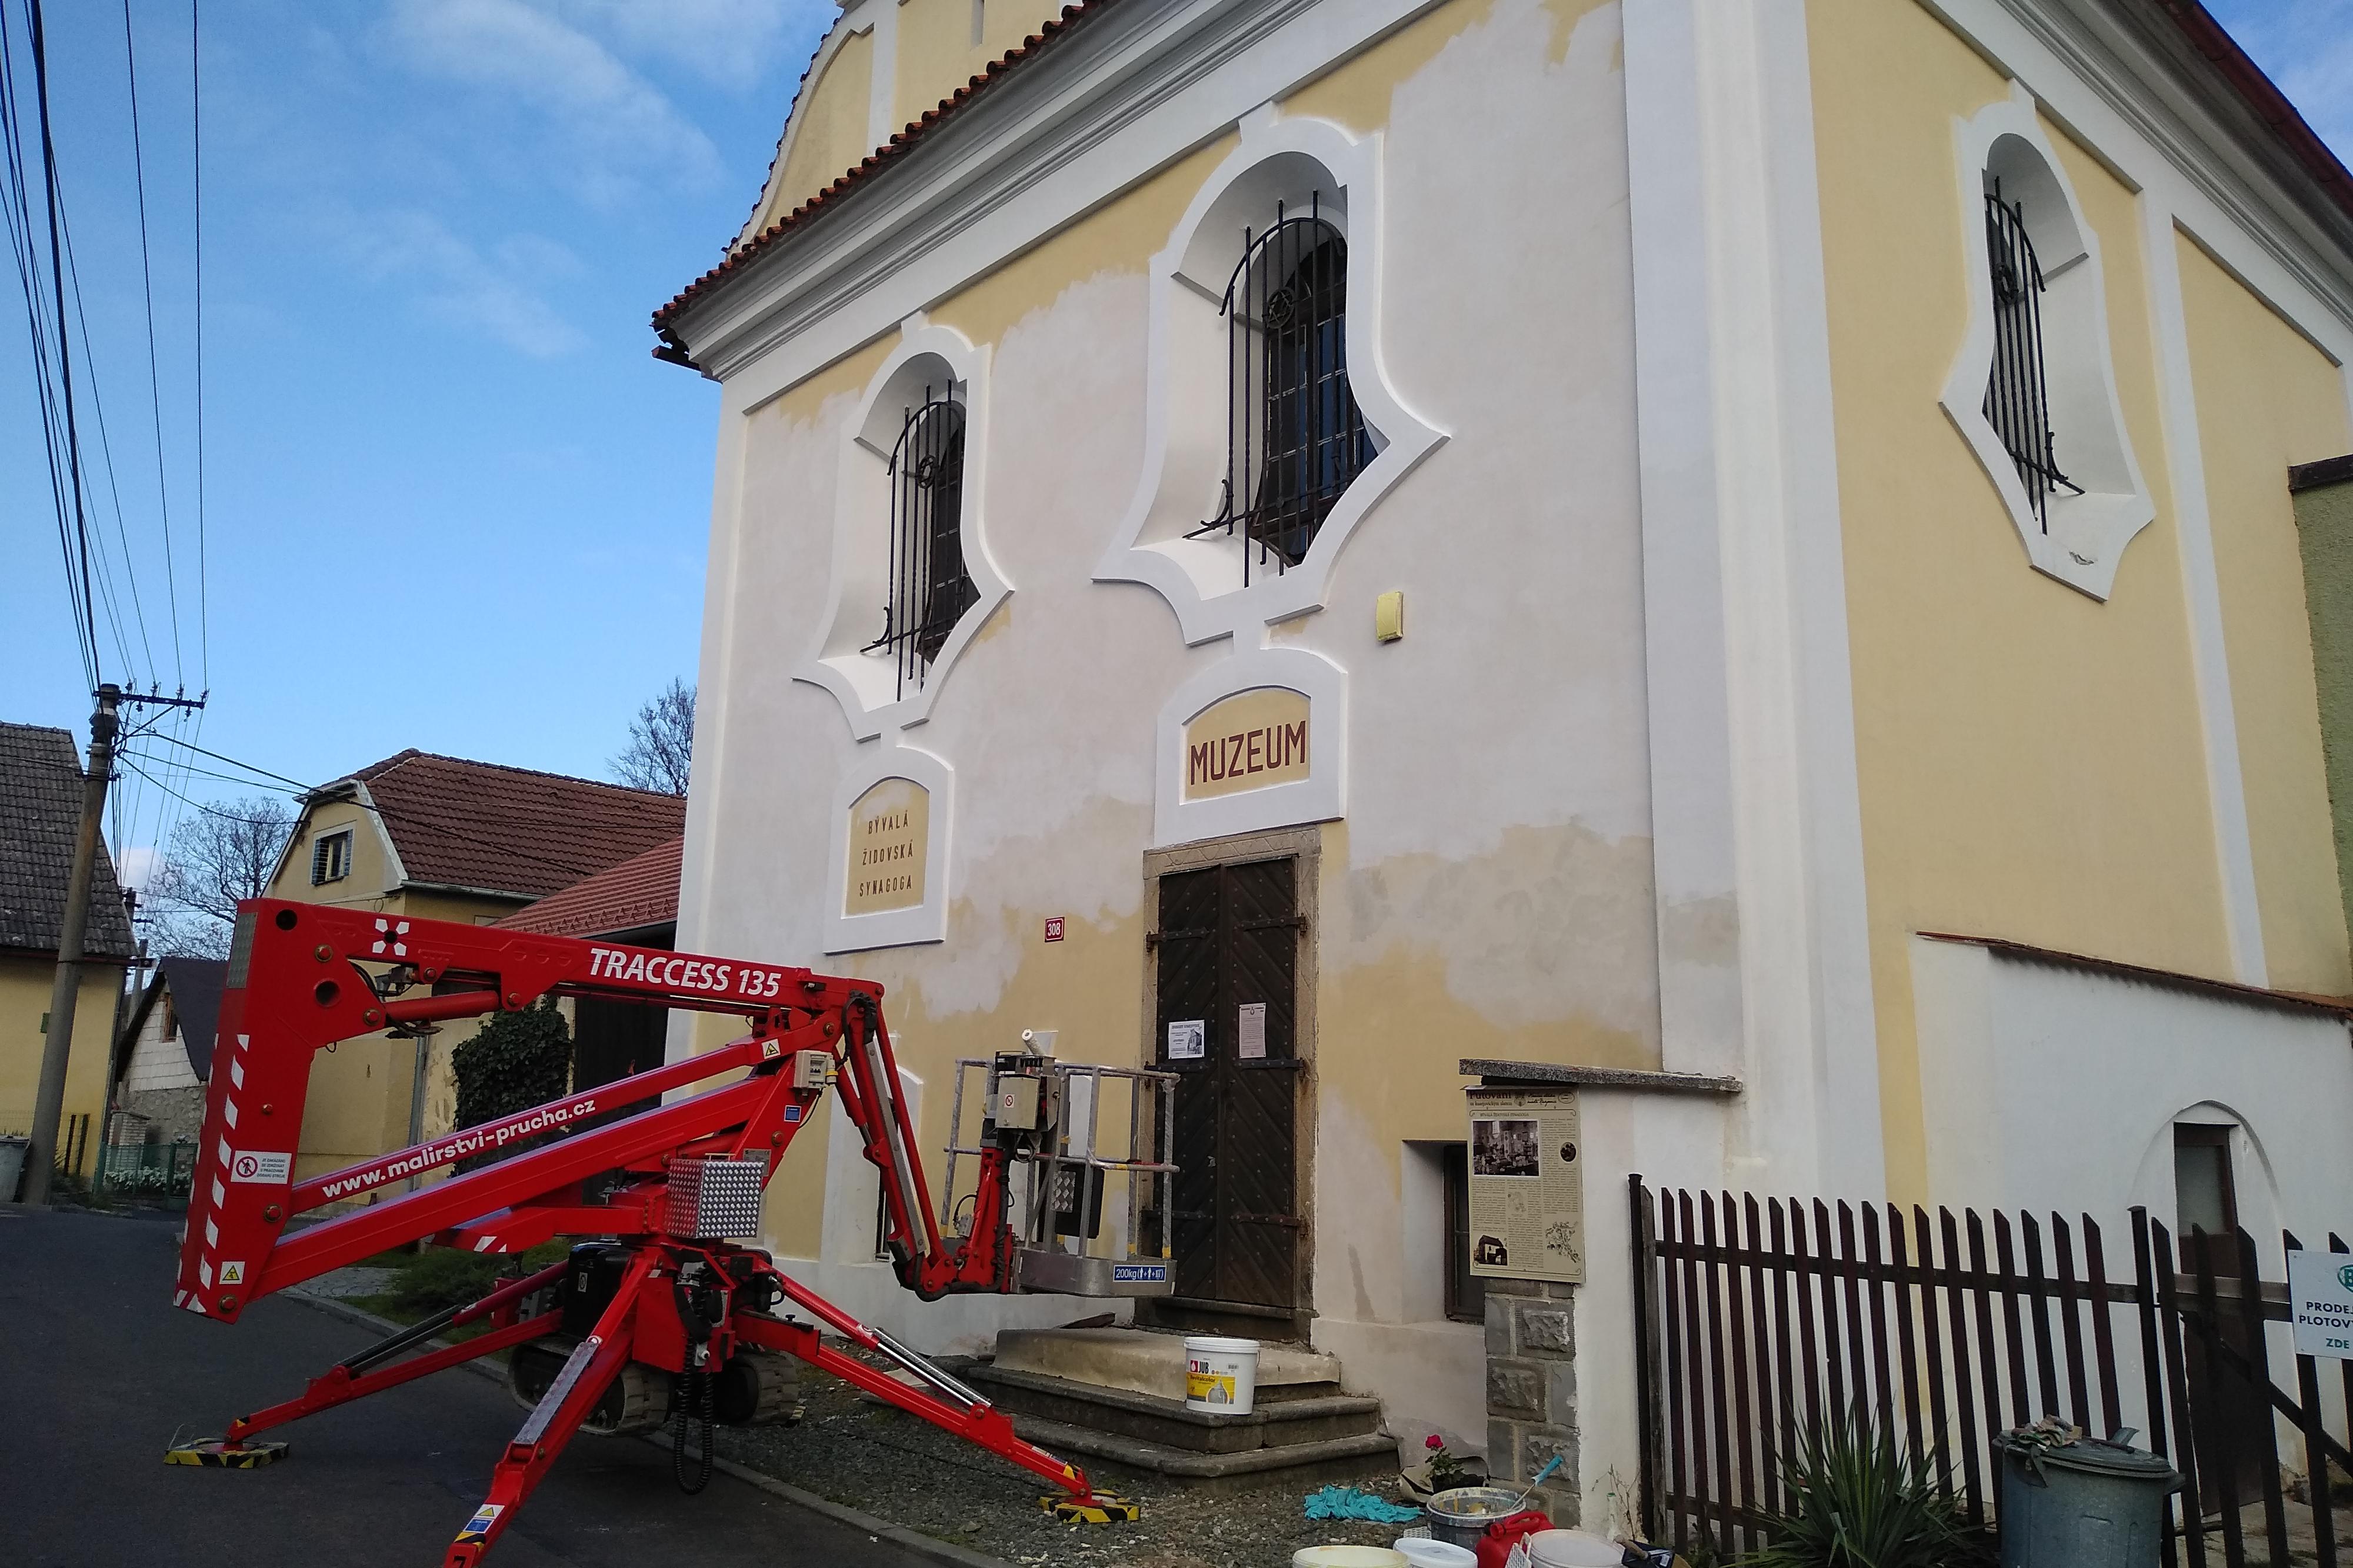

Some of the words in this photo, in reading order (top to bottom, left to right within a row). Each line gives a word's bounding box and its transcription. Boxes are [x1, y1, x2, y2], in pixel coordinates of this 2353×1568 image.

[1191, 720, 1306, 785] MUZEUM
[868, 809, 908, 834] BÝVALÁ
[862, 839, 913, 865] ŽIDOVSKÁ
[859, 875, 912, 897] SYNAGOGA
[1047, 922, 1061, 936] 308
[590, 948, 731, 991] TRACCESS
[738, 969, 782, 997] 135
[322, 1099, 596, 1198] www.malirstvi-prucha.cz
[2299, 1315, 2353, 1328] PLOTOV
[2325, 1338, 2349, 1349] ZDE
[1198, 1361, 1209, 1374] JUB
